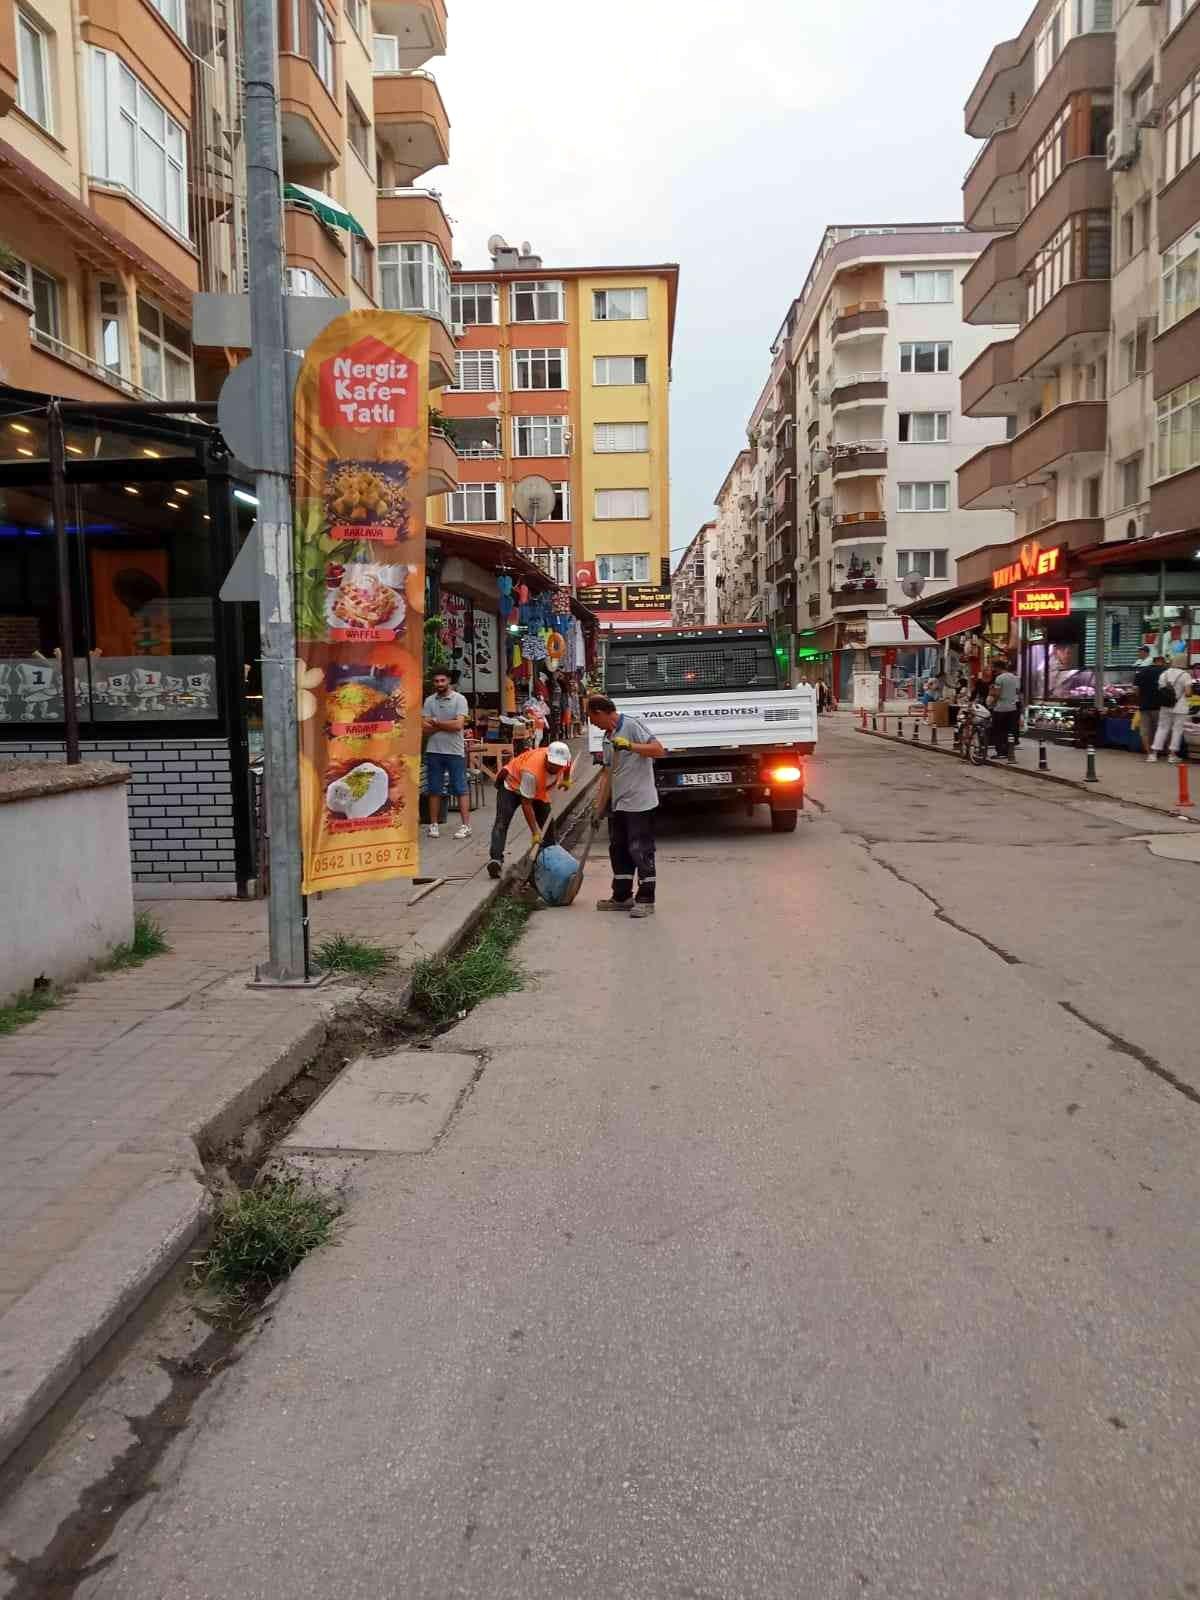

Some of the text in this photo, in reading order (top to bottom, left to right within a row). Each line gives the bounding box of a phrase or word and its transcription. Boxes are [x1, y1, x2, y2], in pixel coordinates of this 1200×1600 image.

[334, 357, 408, 383] Nergiz
[335, 379, 406, 400] Kafe-
[340, 402, 395, 422] Tatlı
[1037, 547, 1059, 575] ET
[345, 629, 381, 640] WAFFLE
[643, 710, 689, 719] YALOVA
[694, 707, 759, 717] BELEDİYESİ
[314, 855, 345, 873] 0542
[351, 851, 372, 867] 112
[375, 848, 391, 863] 69
